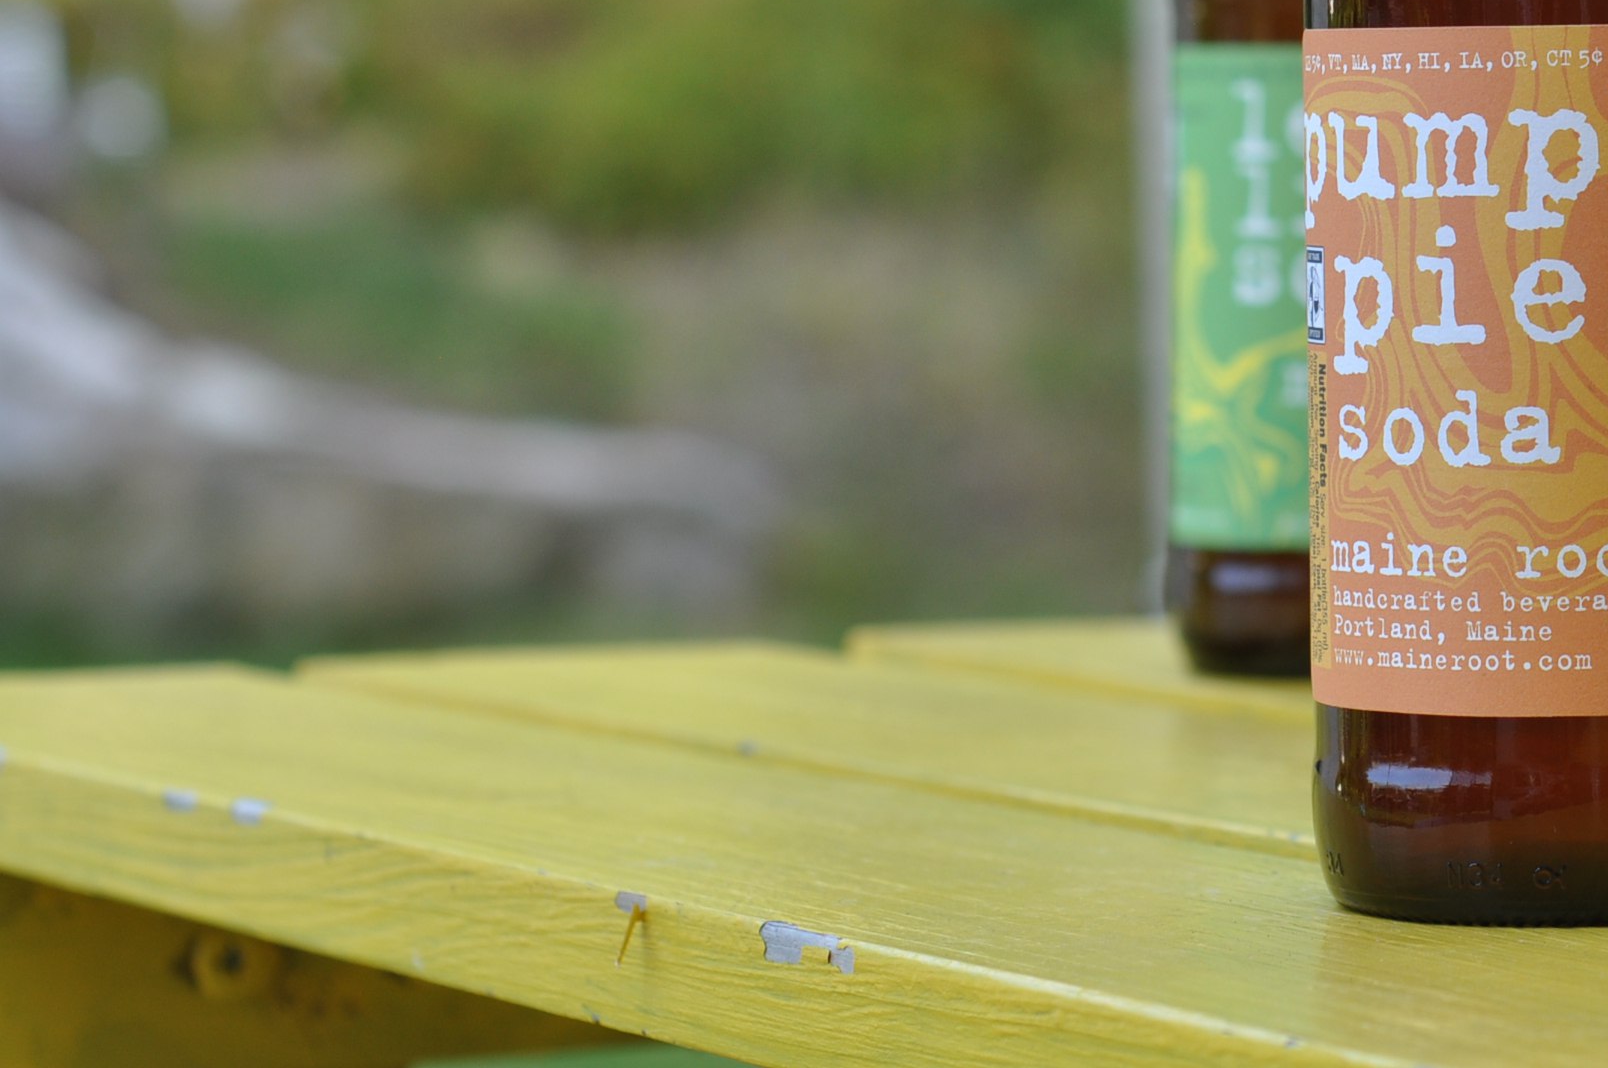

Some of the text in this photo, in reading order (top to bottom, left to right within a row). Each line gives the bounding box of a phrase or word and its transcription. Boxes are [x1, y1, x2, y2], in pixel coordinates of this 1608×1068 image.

[1381, 52, 1412, 74] NY,
[1417, 52, 1451, 73] HI,
[1458, 51, 1494, 72] IA,
[1501, 51, 1538, 70] OR,
[1546, 49, 1573, 66] CT
[1333, 224, 1587, 375] pie
[1338, 390, 1561, 468] soda
[1330, 532, 1469, 578] maine
[1332, 585, 1482, 613] handcrafted
[1333, 614, 1553, 645] Portland, Maine
[1333, 646, 1593, 671] www.maineroot.com
